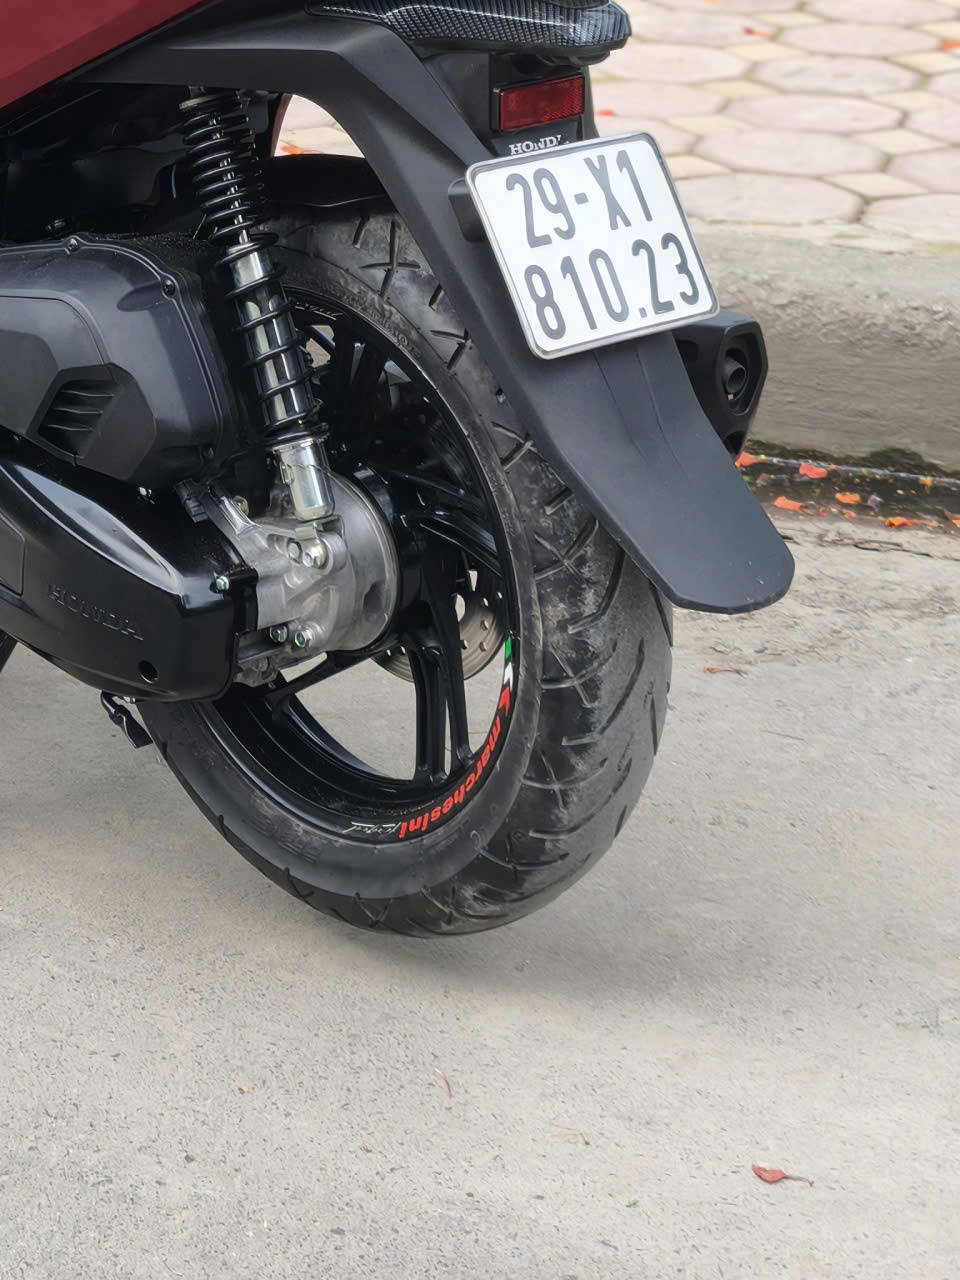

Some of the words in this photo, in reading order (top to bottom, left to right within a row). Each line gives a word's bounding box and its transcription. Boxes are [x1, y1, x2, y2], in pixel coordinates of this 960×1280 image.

[505, 149, 653, 249] 29-X1
[523, 232, 700, 340] 810.23
[48, 584, 144, 640] HONDA
[398, 715, 502, 839] marchesini
